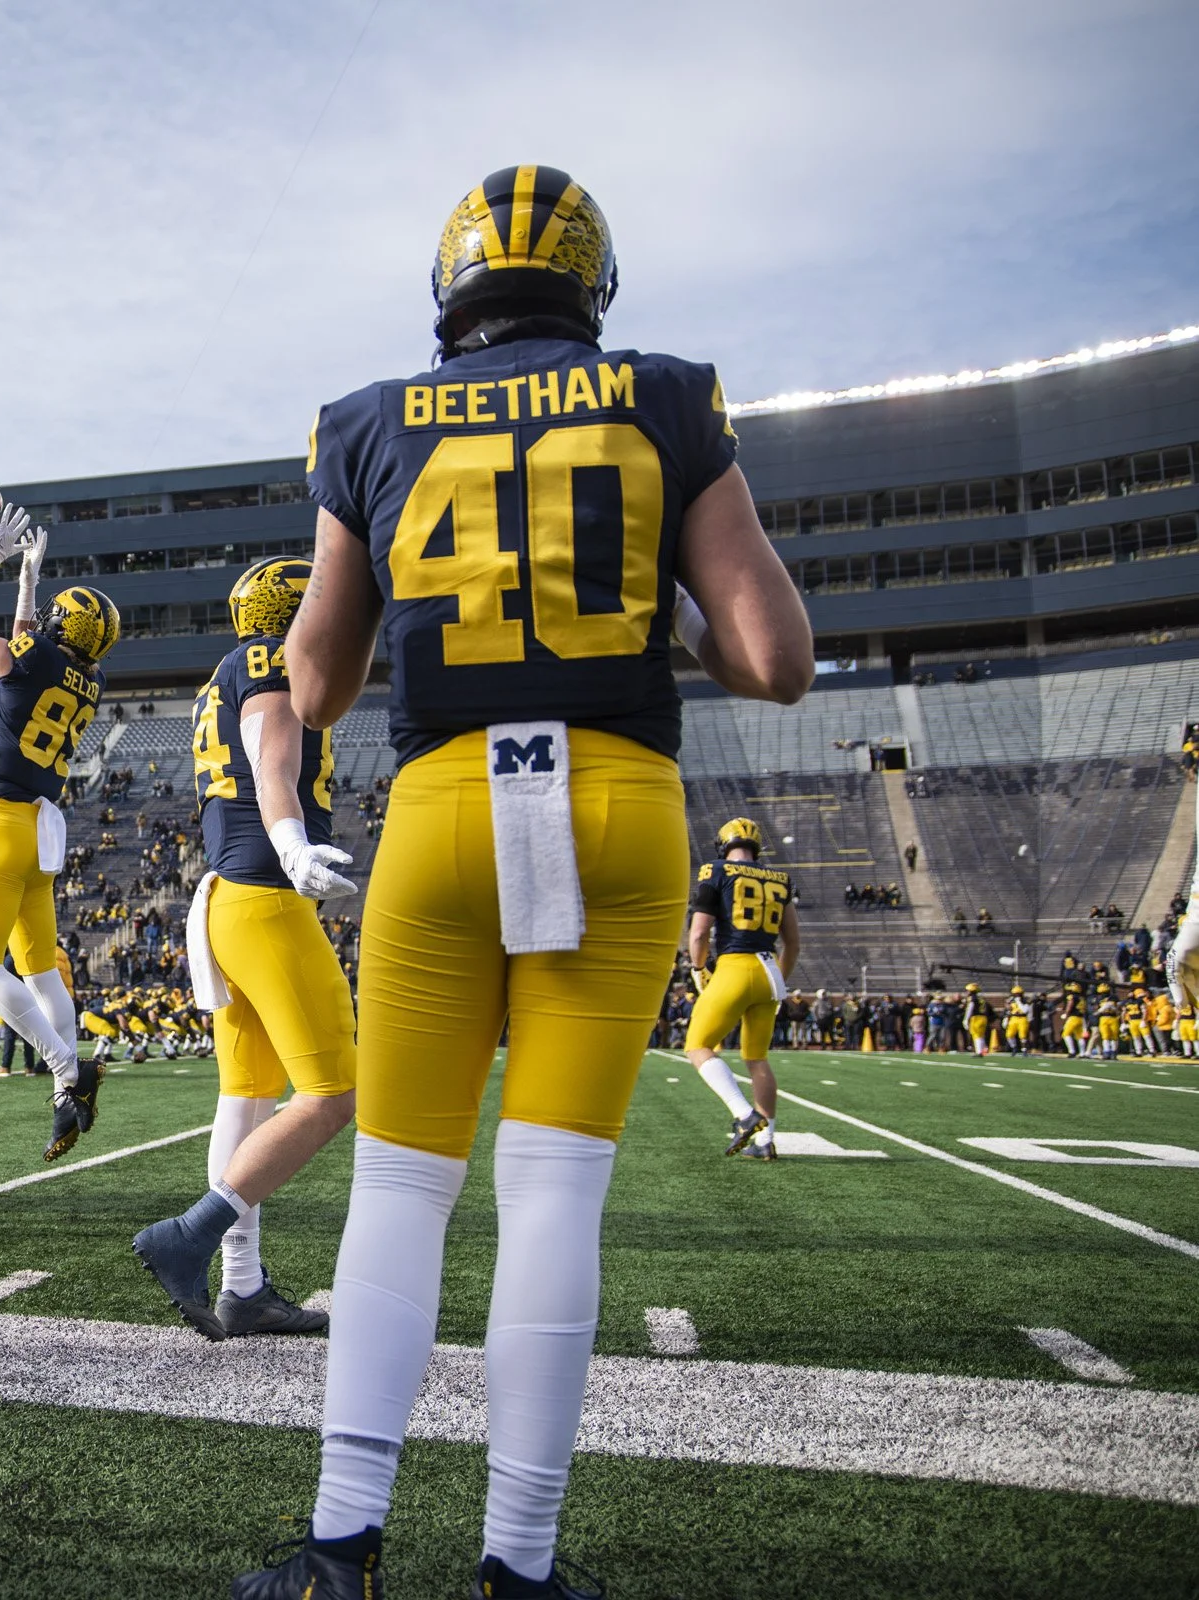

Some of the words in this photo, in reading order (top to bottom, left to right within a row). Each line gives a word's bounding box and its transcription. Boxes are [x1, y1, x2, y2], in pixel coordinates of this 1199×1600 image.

[404, 363, 637, 427] BEETHAM
[388, 423, 664, 667] 40
[493, 735, 555, 775] M
[732, 876, 788, 935] 86
